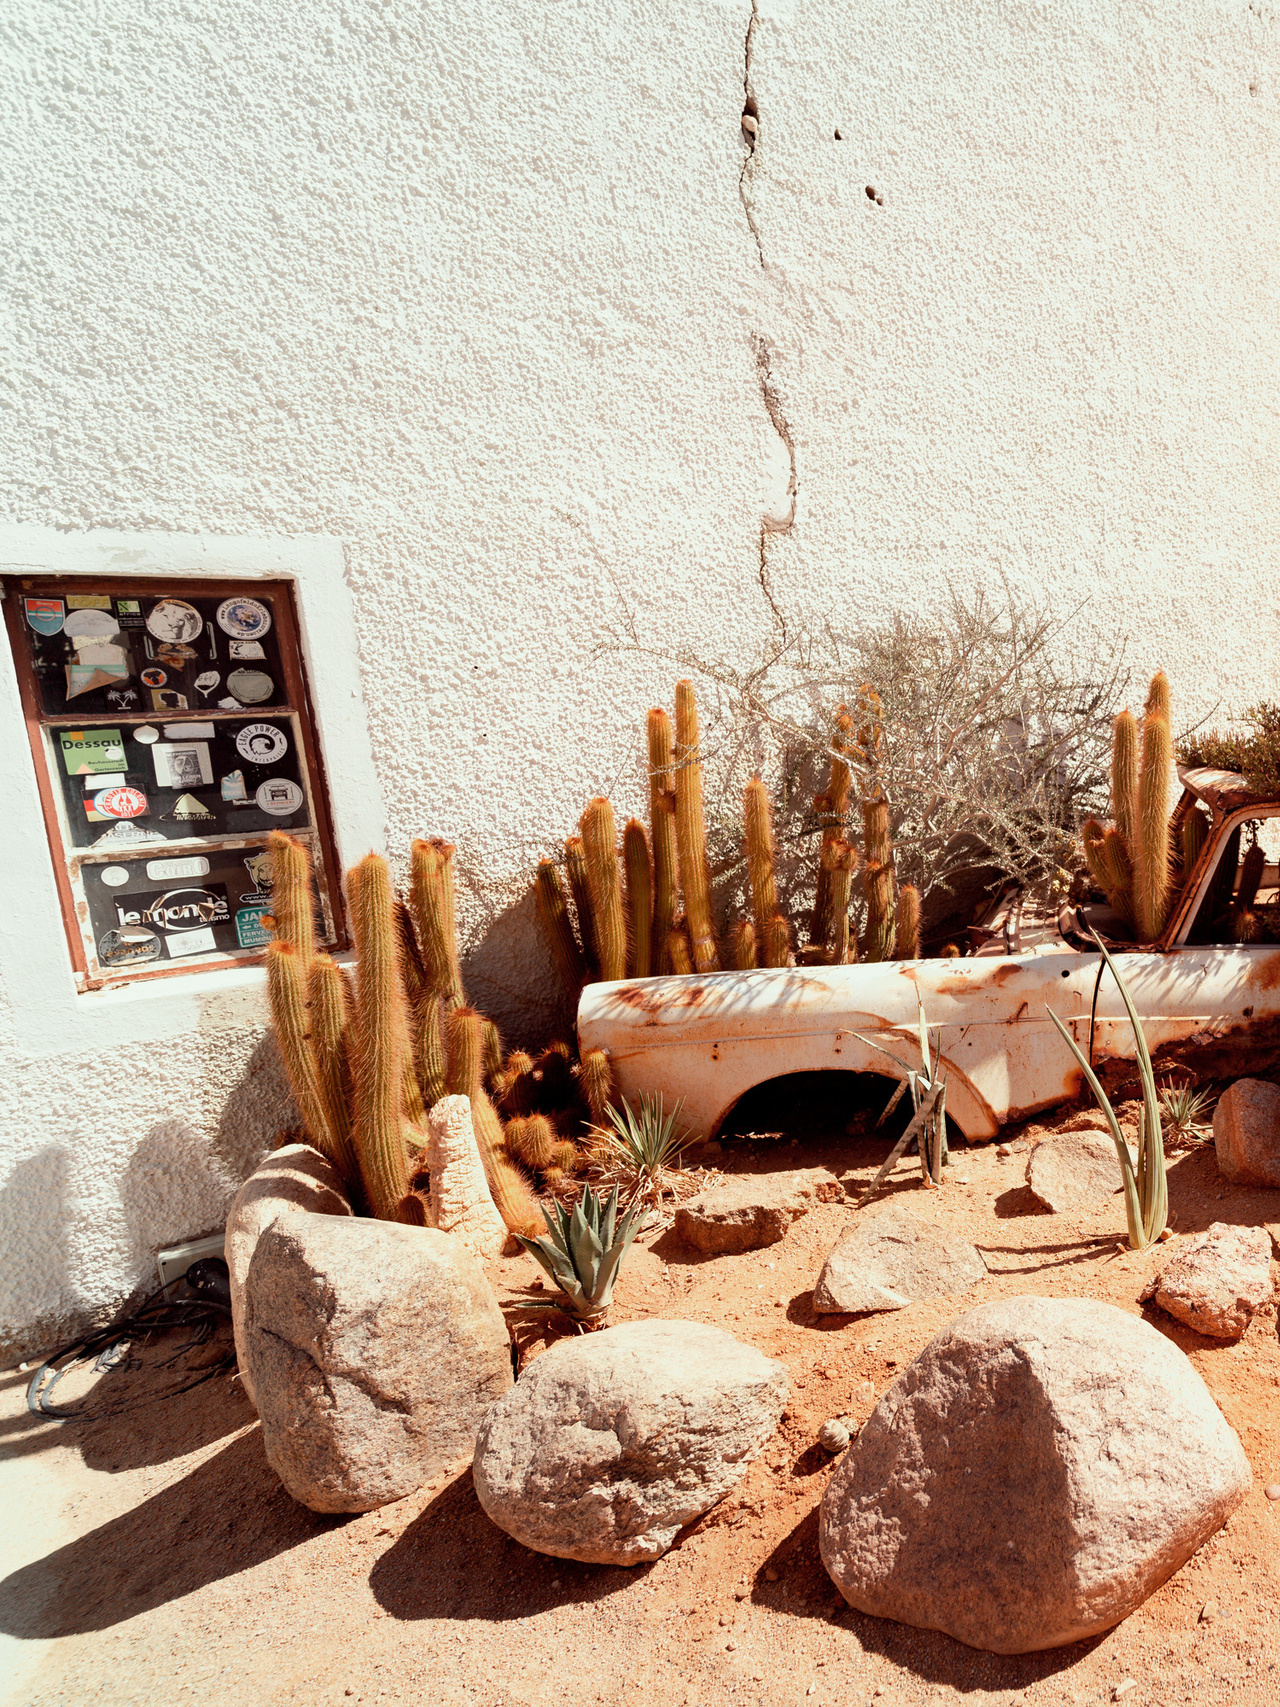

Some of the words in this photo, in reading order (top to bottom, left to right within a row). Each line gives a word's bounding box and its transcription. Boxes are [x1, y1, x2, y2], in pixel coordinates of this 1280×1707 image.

[238, 727, 253, 746] EAGLE
[254, 725, 280, 738] POWER
[62, 740, 121, 750] Dessau
